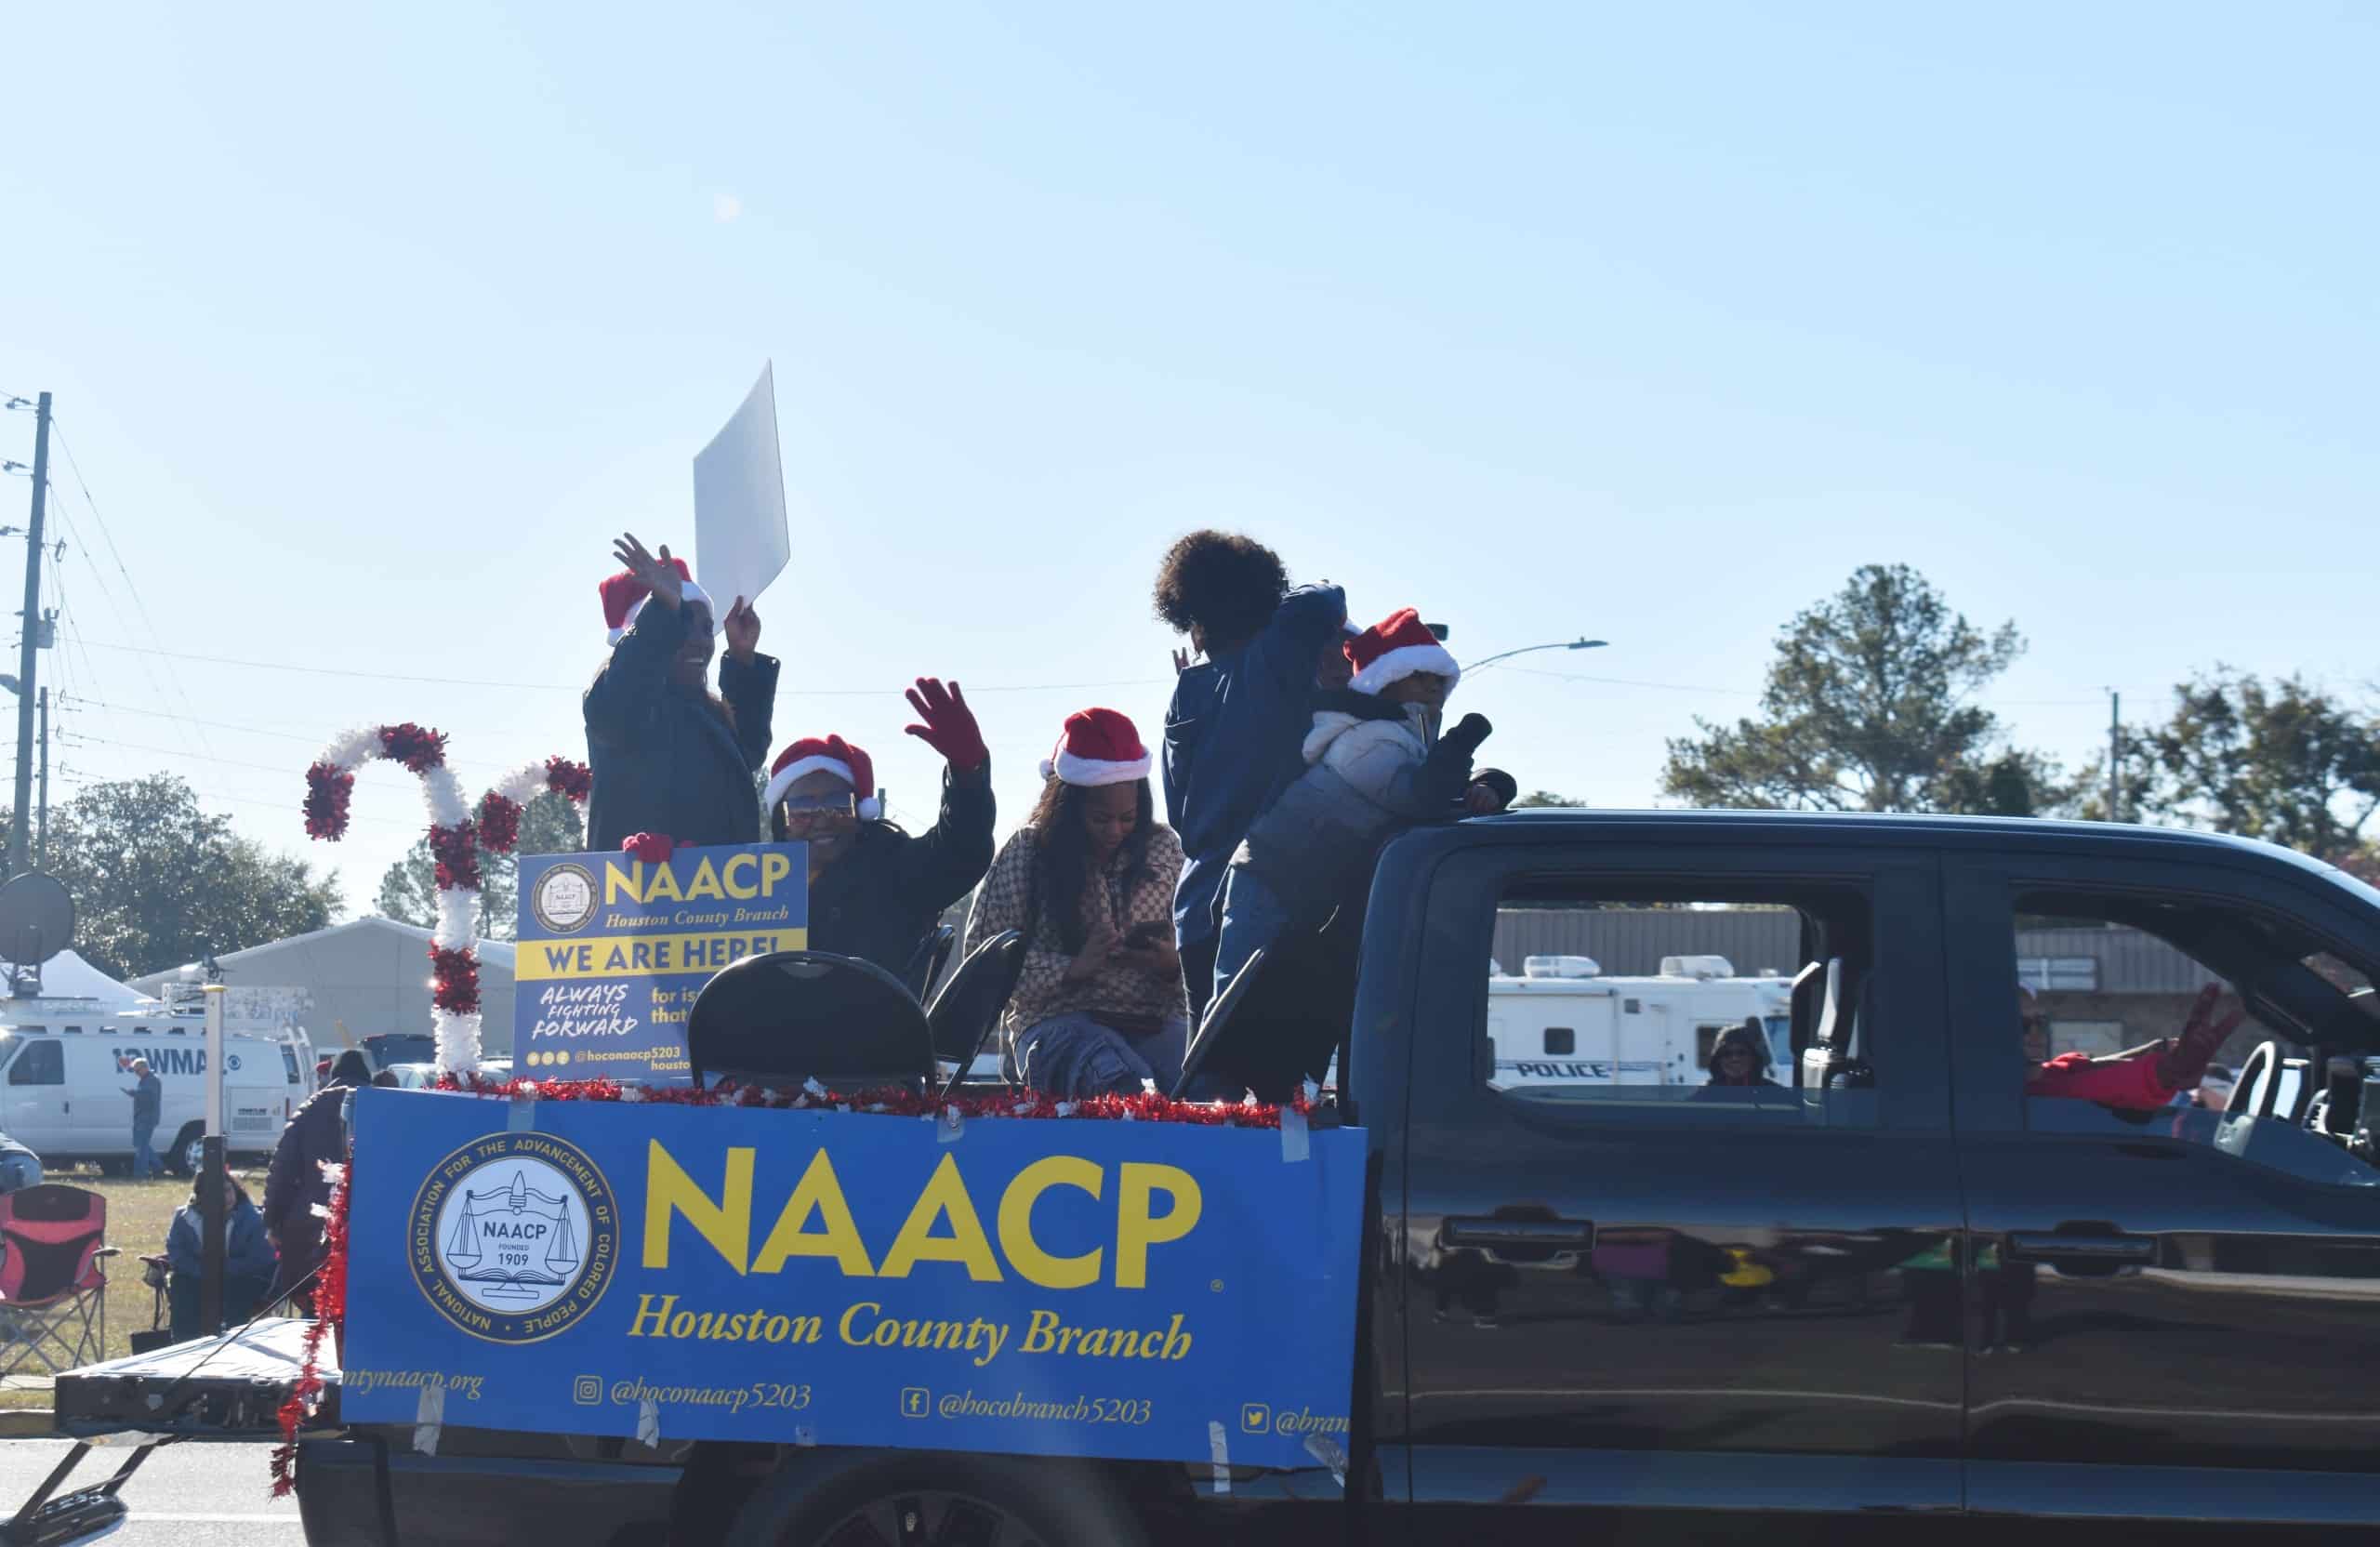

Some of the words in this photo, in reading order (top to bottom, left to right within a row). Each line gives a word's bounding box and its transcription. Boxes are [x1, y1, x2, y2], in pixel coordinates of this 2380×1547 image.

[605, 853, 790, 906] NAACP
[606, 913, 668, 929] Houston
[674, 909, 729, 928] County
[734, 905, 789, 921] Branch
[545, 944, 592, 972] WE
[604, 940, 670, 971] ARE
[682, 936, 778, 968] HERE!
[540, 984, 629, 1005] ALWAYS
[651, 986, 677, 1004] for
[548, 1003, 620, 1020] FIGHTING
[651, 1006, 687, 1025] that
[532, 1017, 639, 1040] FORWARD
[575, 1046, 681, 1064] @hoconaacp5203
[1515, 1063, 1610, 1078] POLICE
[477, 1140, 507, 1157] THE
[443, 1155, 472, 1179] FOR
[514, 1139, 602, 1198] ADVANCEMENT
[596, 1205, 611, 1224] OF
[642, 1138, 1202, 1289] NAACP
[416, 1181, 445, 1274] ASSOCIATION
[483, 1222, 547, 1240] NAACP
[498, 1243, 530, 1251] FOUNDED
[498, 1252, 529, 1266] 1909
[578, 1234, 611, 1299] COLORED
[432, 1279, 492, 1330] NATIONAL
[525, 1300, 578, 1333] PEOPLE
[627, 1293, 823, 1344] Houston
[839, 1302, 1009, 1366] County
[1018, 1310, 1193, 1361] Branch
[610, 1375, 813, 1413] @hoconaacp5203
[938, 1389, 1153, 1425] @hocobranch5203
